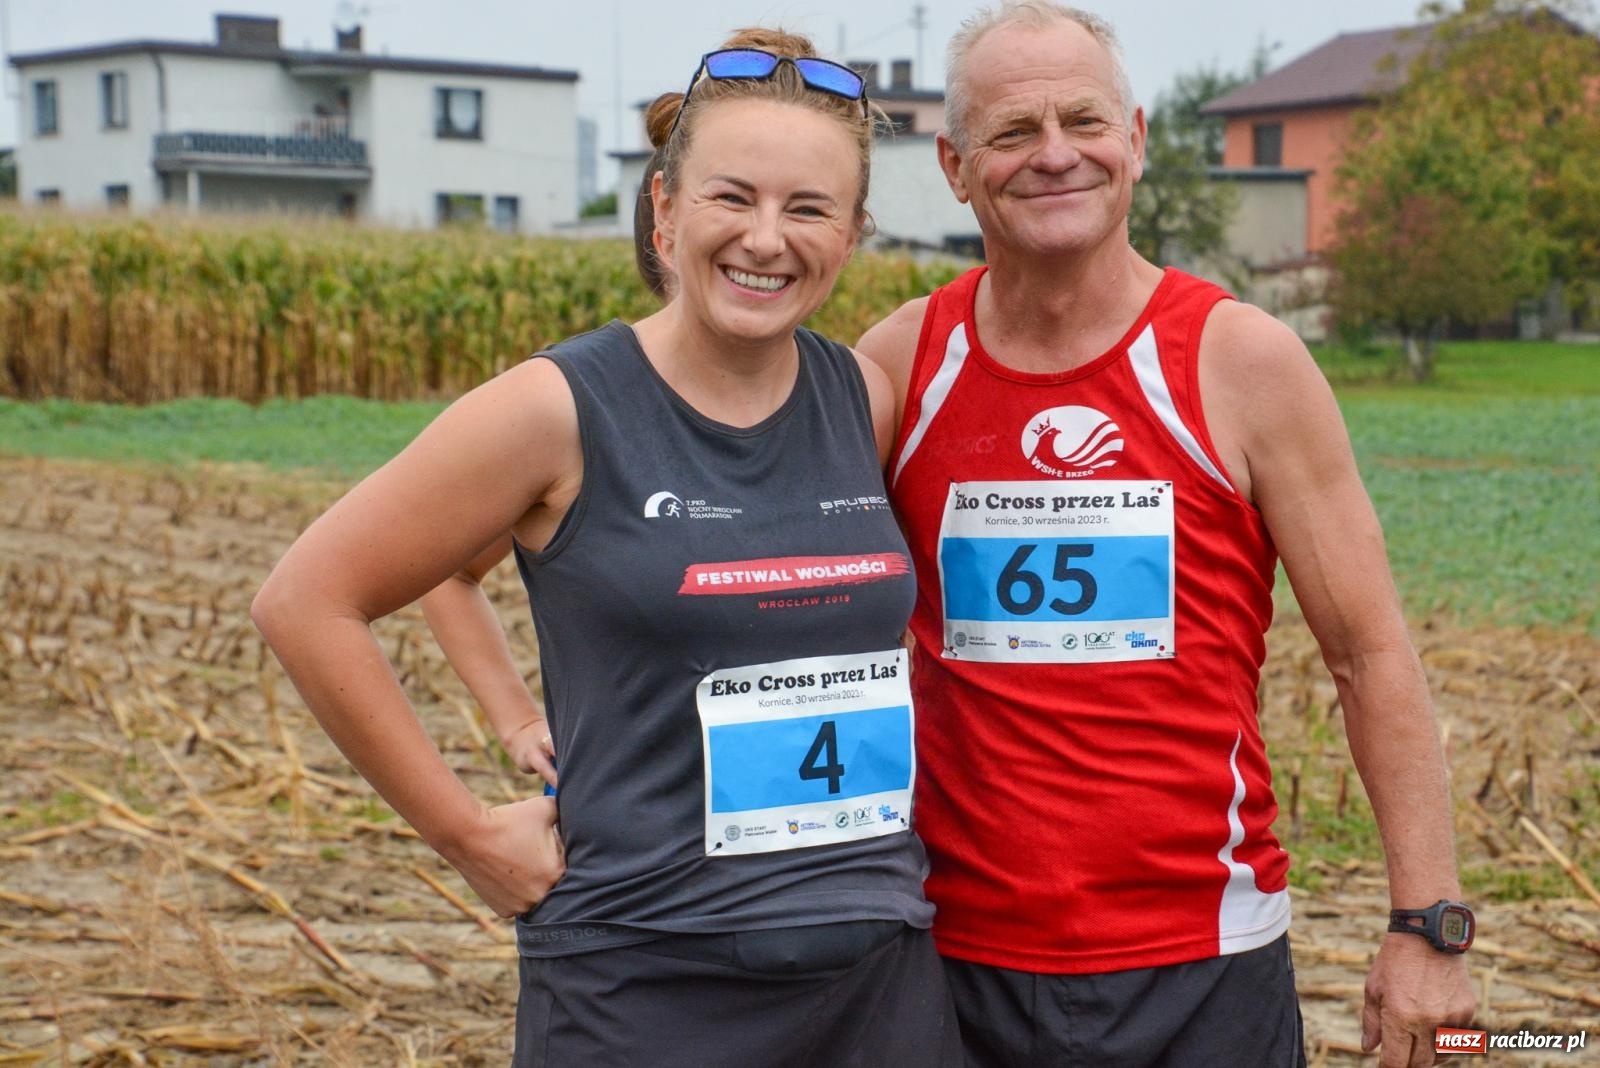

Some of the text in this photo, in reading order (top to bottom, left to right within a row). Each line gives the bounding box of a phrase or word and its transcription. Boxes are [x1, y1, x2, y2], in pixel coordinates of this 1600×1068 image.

[1065, 469, 1095, 478] BRZEG
[985, 493, 1046, 510] Cross
[1051, 493, 1115, 512] przez
[1121, 491, 1161, 508] Las
[985, 515, 1110, 526] Kornice, 30 września 2023 r.
[696, 561, 887, 586] FESTIWAL WOLNOŚCI
[996, 543, 1098, 616] 65
[710, 663, 898, 696] Eko Cross przez Las
[758, 697, 794, 708] Kornice,
[795, 695, 807, 705] 30
[807, 692, 841, 703] września
[842, 690, 861, 700] 2023
[798, 720, 845, 794] 4
